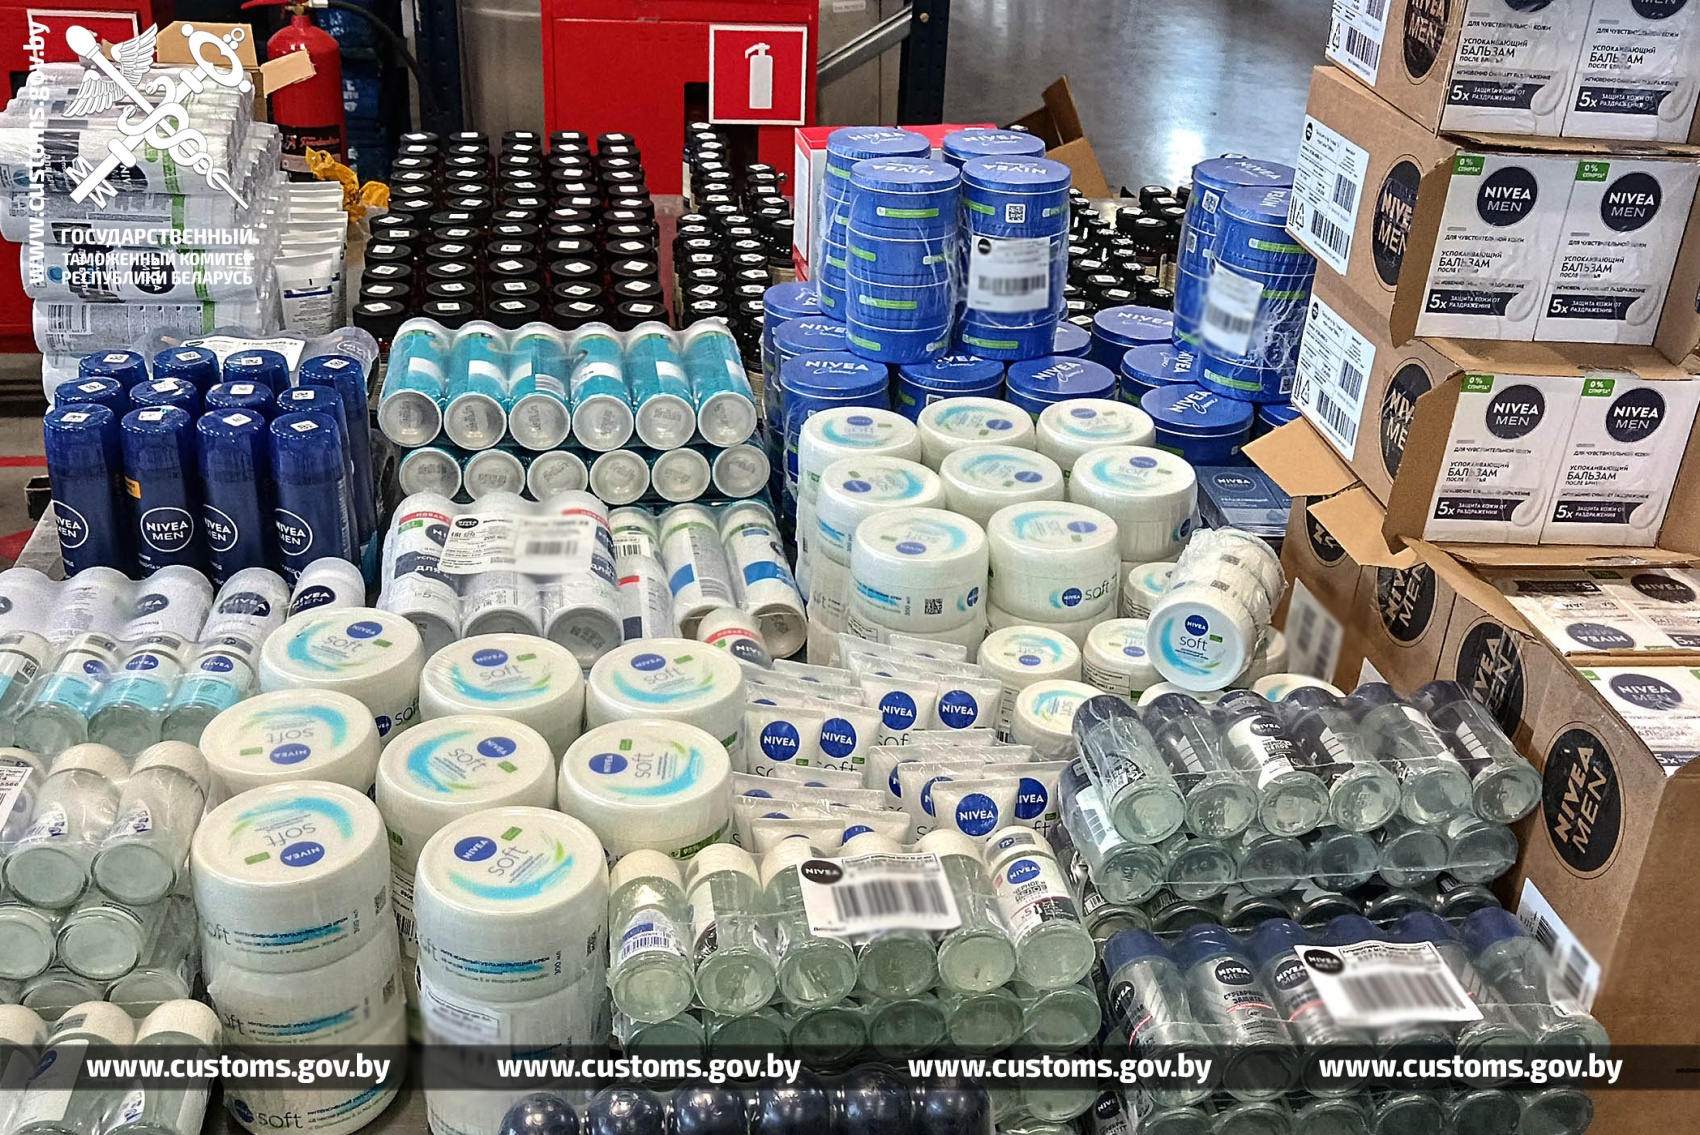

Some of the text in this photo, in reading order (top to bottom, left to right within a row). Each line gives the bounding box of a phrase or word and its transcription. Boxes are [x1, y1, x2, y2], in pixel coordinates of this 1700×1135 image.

[1461, 46, 1515, 57] БАЛЬЗАМ
[982, 164, 1048, 175] NIVEA
[1484, 187, 1532, 200] NIVEA
[1608, 192, 1655, 206] NIVEA
[1381, 191, 1412, 232] NIVE
[1486, 201, 1522, 212] MEN
[1610, 206, 1645, 218] MEN
[1438, 257, 1490, 268] БАЛЬЗАМ
[1561, 262, 1612, 273] БАЛЬЗАМ
[800, 322, 846, 333] NIVE
[805, 360, 870, 371] NIVEA
[1031, 361, 1082, 381] NIVEA
[1168, 391, 1212, 413] NIVEA
[1493, 402, 1539, 416] NIVEA
[1613, 406, 1659, 419] NIVEA
[1495, 415, 1530, 427] MEN
[1614, 419, 1650, 430] MEN
[1567, 470, 1617, 482] БАЛЬЗАМ
[146, 520, 189, 532] NIVEA
[152, 531, 184, 541] MEN
[1638, 582, 1687, 591] NIVEA
[351, 624, 377, 636] NIVEA
[1186, 620, 1207, 631] NIVEA
[323, 634, 364, 652] soft
[1179, 636, 1208, 652] soft
[1577, 634, 1629, 643] NIVEA
[128, 660, 155, 668] NIVEA
[475, 652, 503, 664] NIVEA
[635, 657, 662, 668] NIVEA
[203, 661, 230, 669] NIVEA
[479, 665, 524, 682] soft
[644, 666, 686, 686] soft
[1617, 685, 1671, 694] NIVEA
[882, 705, 914, 717] NIVEA
[942, 704, 975, 716] NIVEA
[266, 727, 314, 744] soft
[764, 735, 796, 747] NIVEA
[822, 732, 853, 745] NIVEA
[274, 749, 308, 758] NIVEA
[486, 740, 509, 756] NIVEA
[448, 747, 487, 773] soft
[604, 754, 616, 774] NIVEA
[635, 751, 655, 779] soft
[1553, 747, 1595, 843] NIVEA
[959, 809, 995, 820] NIVEA
[1572, 765, 1607, 854] MEN
[264, 823, 317, 848] soft
[284, 847, 320, 861] NIVEA
[463, 838, 489, 861] NIVEA
[487, 845, 529, 877] soft
[1009, 865, 1038, 880] NIVEA
[1219, 967, 1250, 976] NIVEA
[258, 1112, 304, 1129] soft
